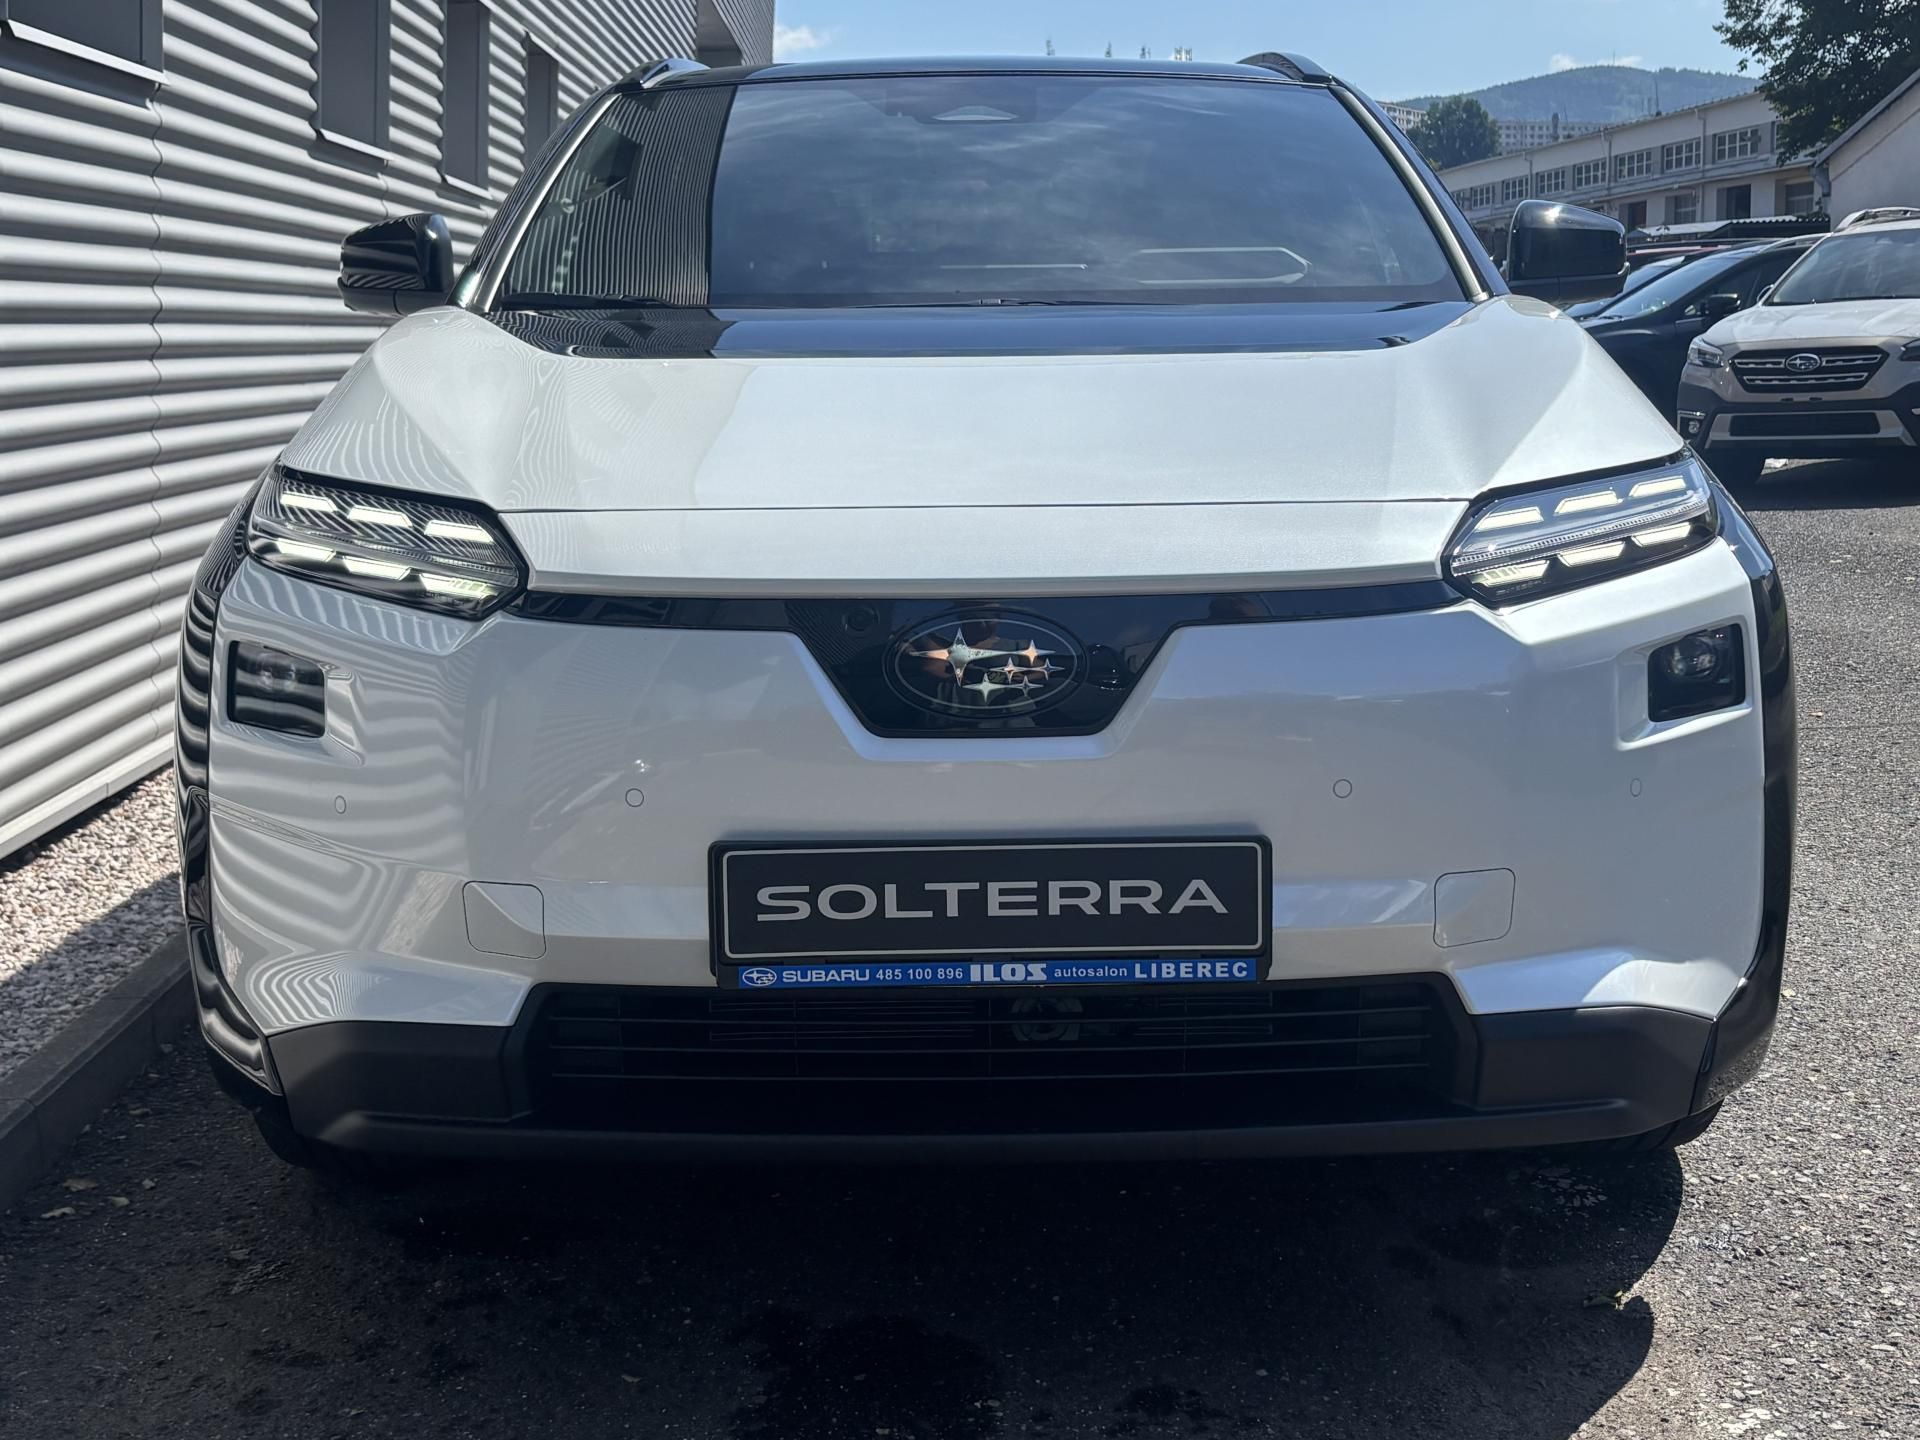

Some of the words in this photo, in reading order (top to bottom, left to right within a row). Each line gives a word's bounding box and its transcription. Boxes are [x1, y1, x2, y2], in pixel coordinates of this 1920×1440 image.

[757, 879, 1229, 922] SOLTERRA
[782, 969, 870, 982] SUBARU
[875, 968, 902, 981] 485
[907, 967, 932, 980] 100
[937, 967, 963, 979] 896
[970, 963, 1047, 982] ILOS
[1053, 965, 1128, 978] autosalon
[1134, 962, 1248, 979] LIBEREC
